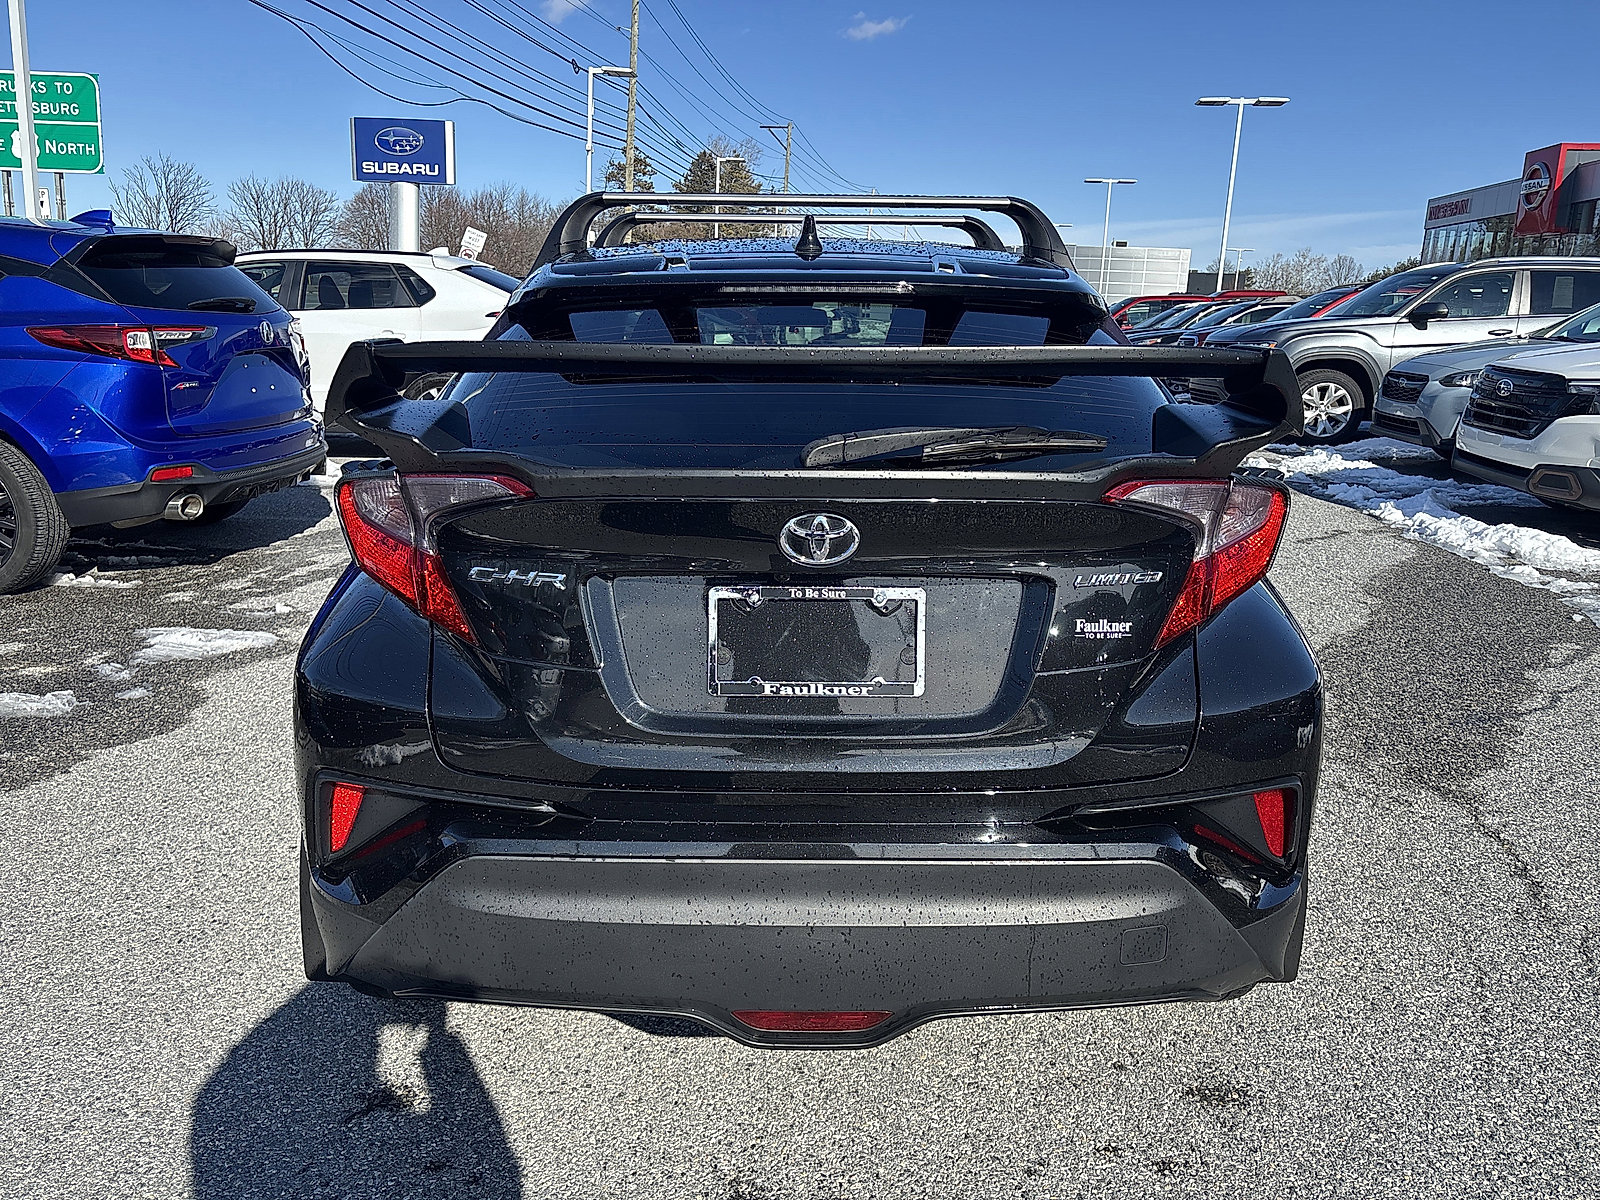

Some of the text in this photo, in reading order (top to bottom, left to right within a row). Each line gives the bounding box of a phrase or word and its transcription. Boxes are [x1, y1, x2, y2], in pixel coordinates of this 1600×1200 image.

[0, 80, 73, 94] RUKS TO
[362, 161, 439, 176] SUBARU
[467, 566, 567, 591] C-HR
[1073, 571, 1163, 589] LIMITED
[788, 588, 847, 599] To Be Sure
[1074, 618, 1133, 633] Faulkner
[761, 682, 874, 696] Faulkner
